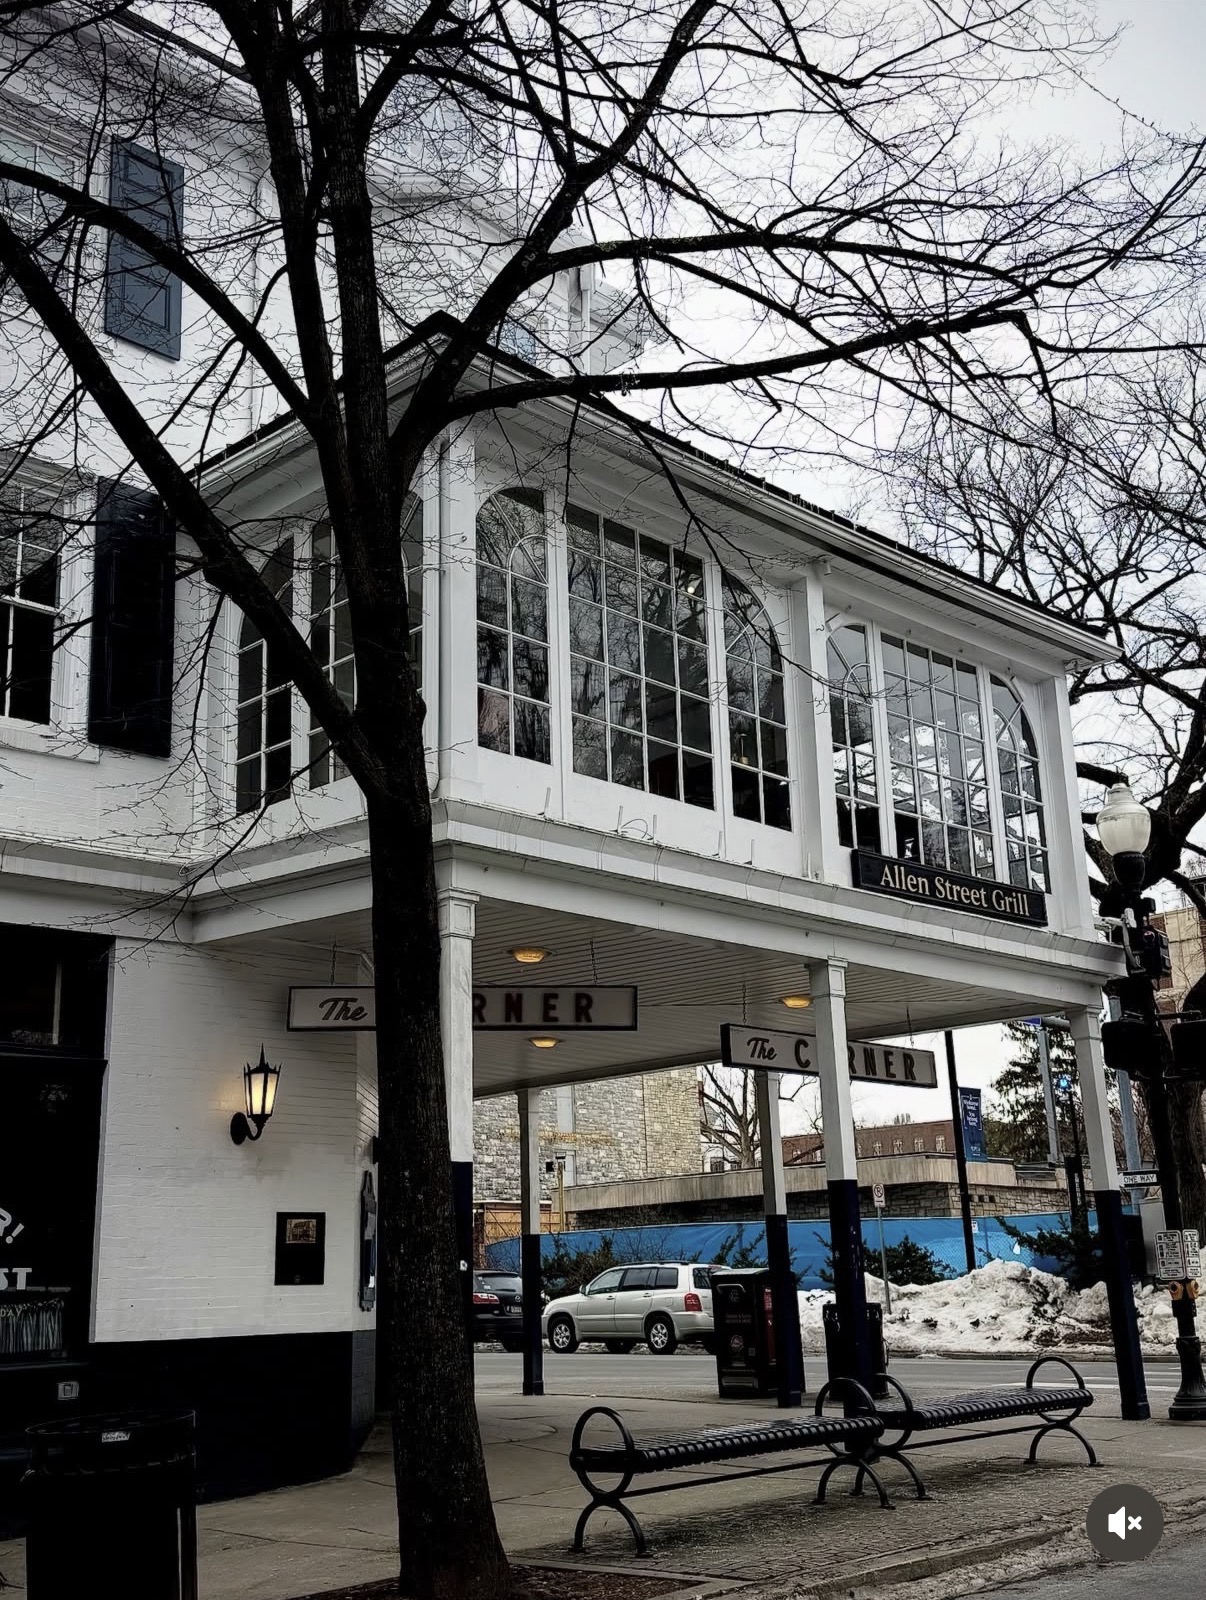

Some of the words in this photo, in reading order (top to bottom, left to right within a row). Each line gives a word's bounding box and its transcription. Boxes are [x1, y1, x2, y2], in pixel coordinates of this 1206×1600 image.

[881, 864, 929, 895] Allen
[935, 876, 987, 907] Street
[992, 889, 1030, 917] Grill
[318, 997, 368, 1022] The
[472, 993, 594, 1023] RNER
[746, 1037, 778, 1061] The
[794, 1039, 917, 1080] CRNER
[1124, 1174, 1138, 1184] ONE
[1140, 1174, 1155, 1183] WAY
